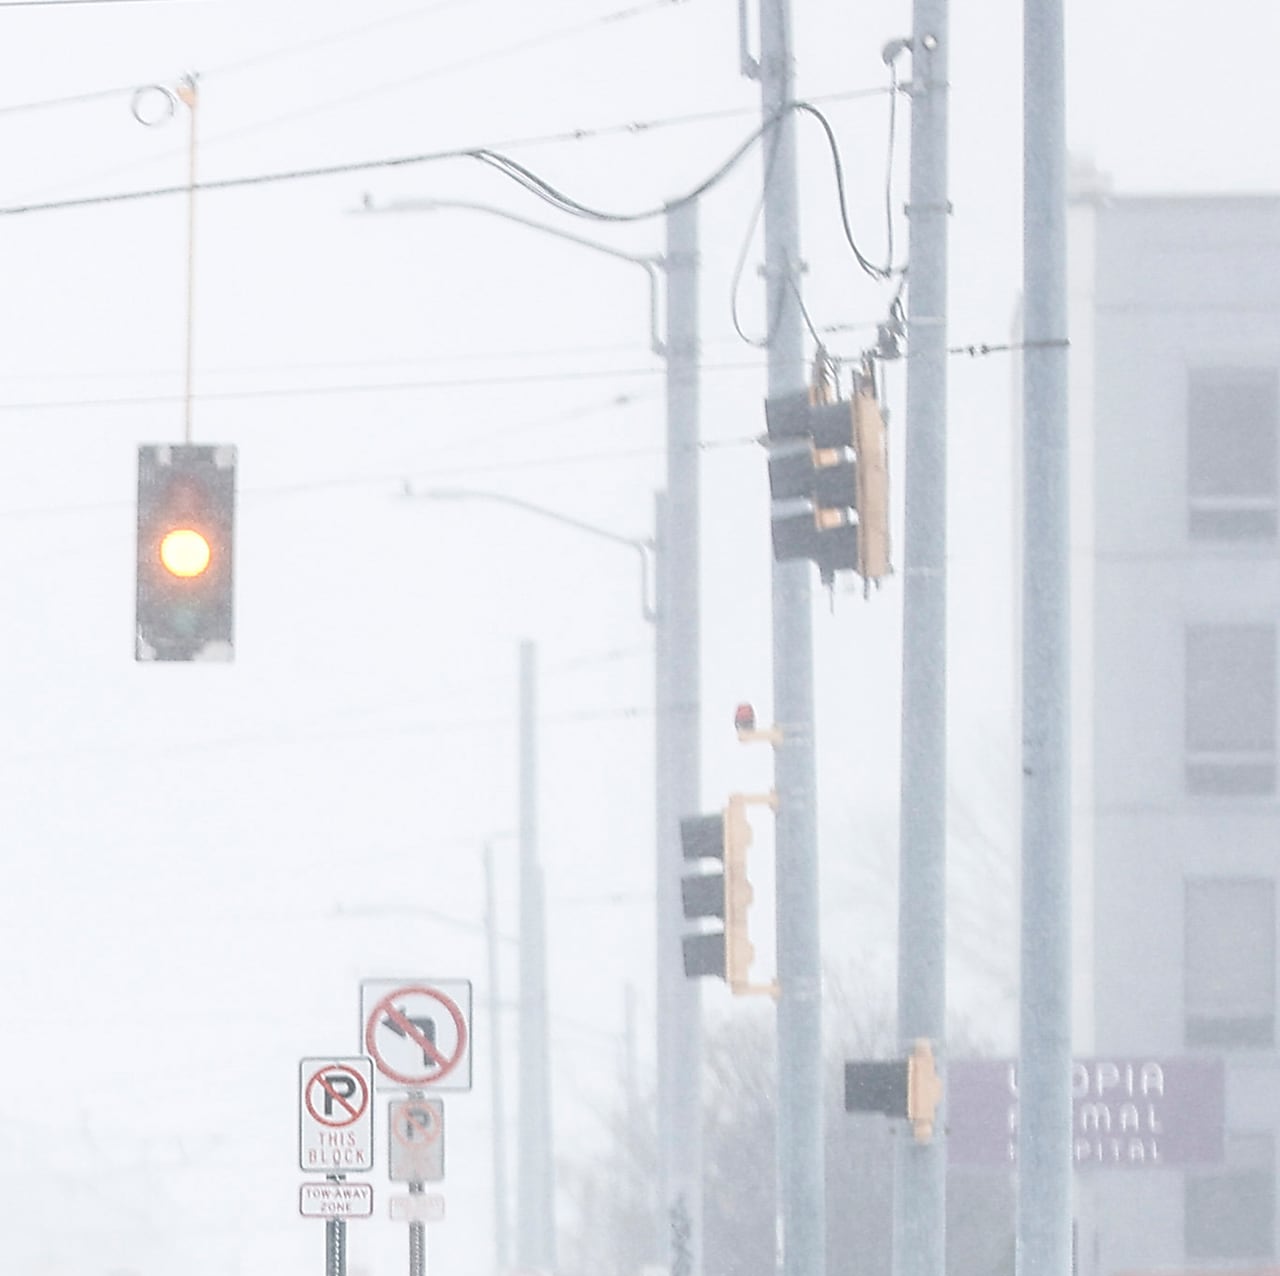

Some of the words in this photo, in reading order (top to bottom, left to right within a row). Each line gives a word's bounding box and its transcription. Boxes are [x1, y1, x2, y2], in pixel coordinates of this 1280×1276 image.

[1007, 1062, 1164, 1098] OPIA
[324, 1075, 357, 1116] P
[1007, 1103, 1162, 1133] MAL
[318, 1131, 356, 1147] THIS
[308, 1150, 365, 1164] BLOCK
[306, 1188, 368, 1199] TOW-AWAY
[320, 1202, 352, 1212] ZONE
